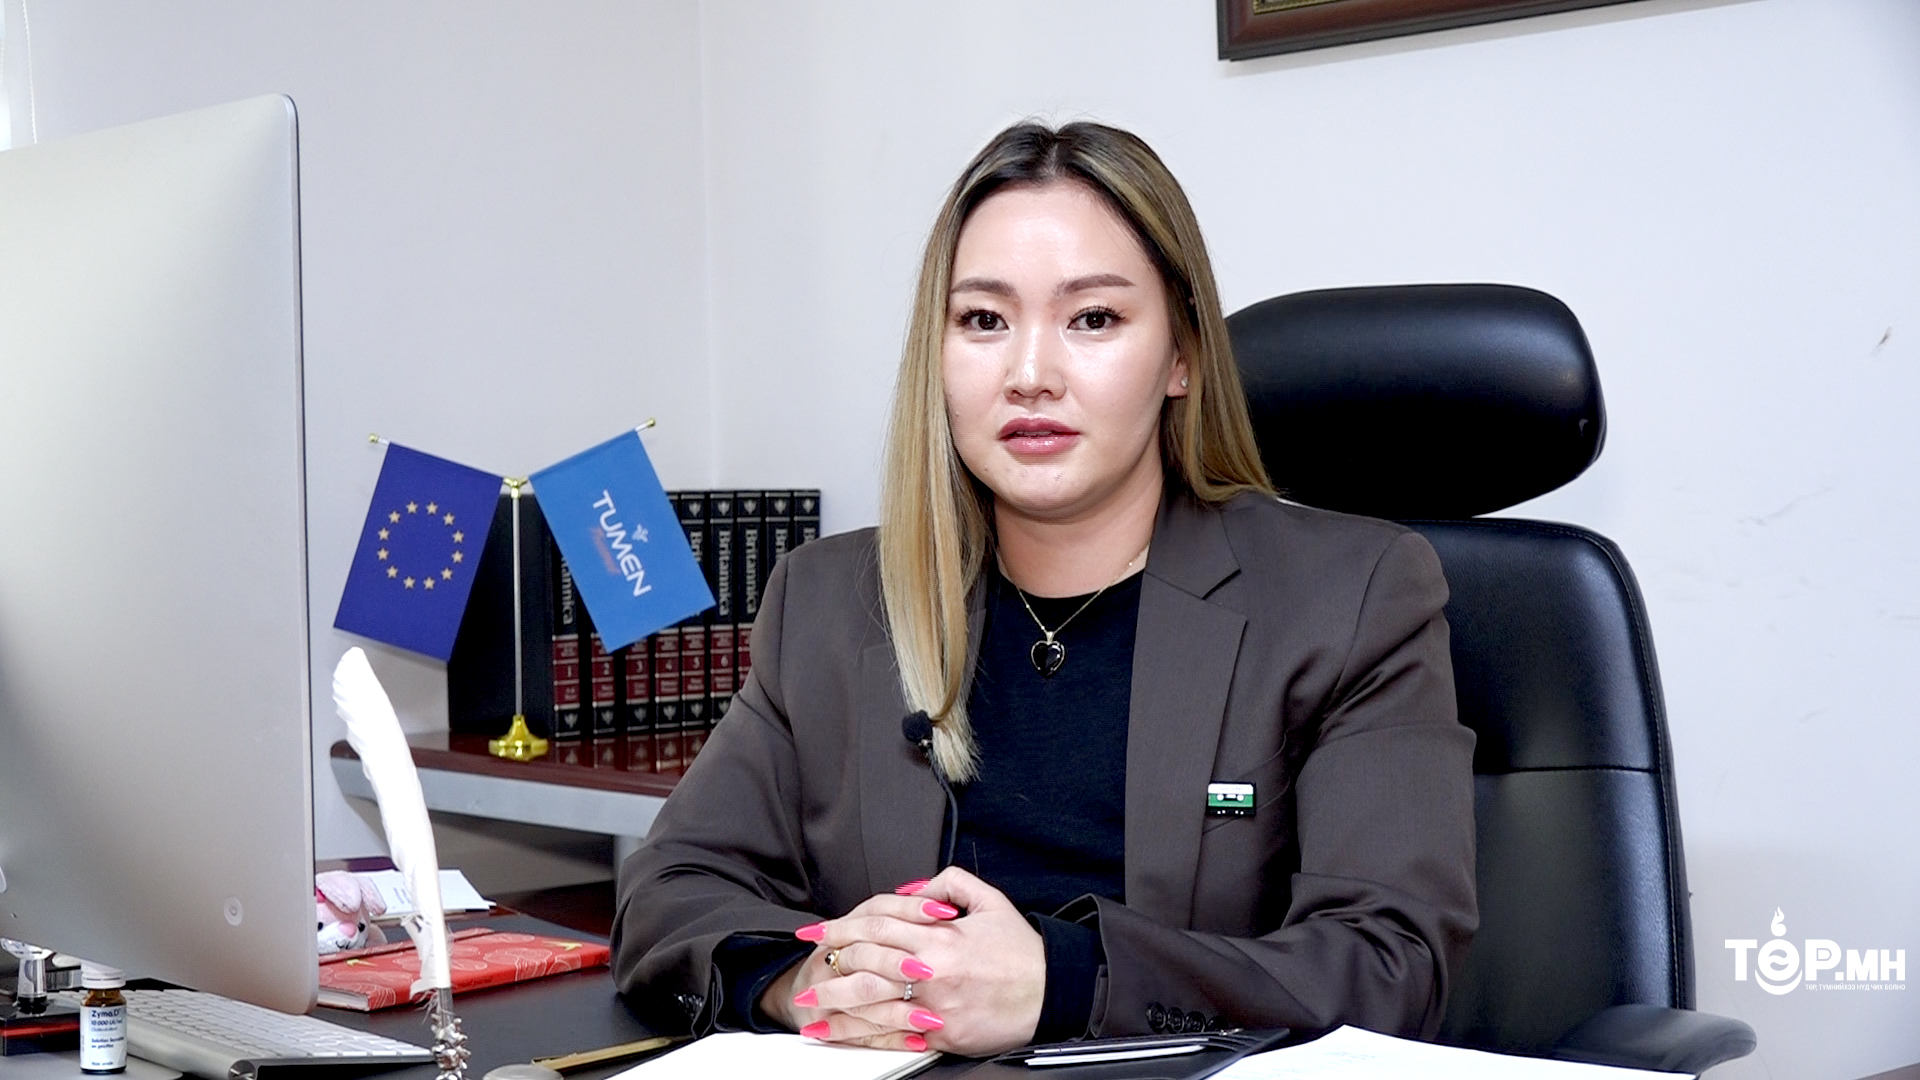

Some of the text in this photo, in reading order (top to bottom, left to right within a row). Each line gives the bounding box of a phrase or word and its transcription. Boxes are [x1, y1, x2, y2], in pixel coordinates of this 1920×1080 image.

[592, 489, 652, 597] TUMEN
[718, 530, 731, 616] Britannica
[745, 528, 758, 614] Britannica
